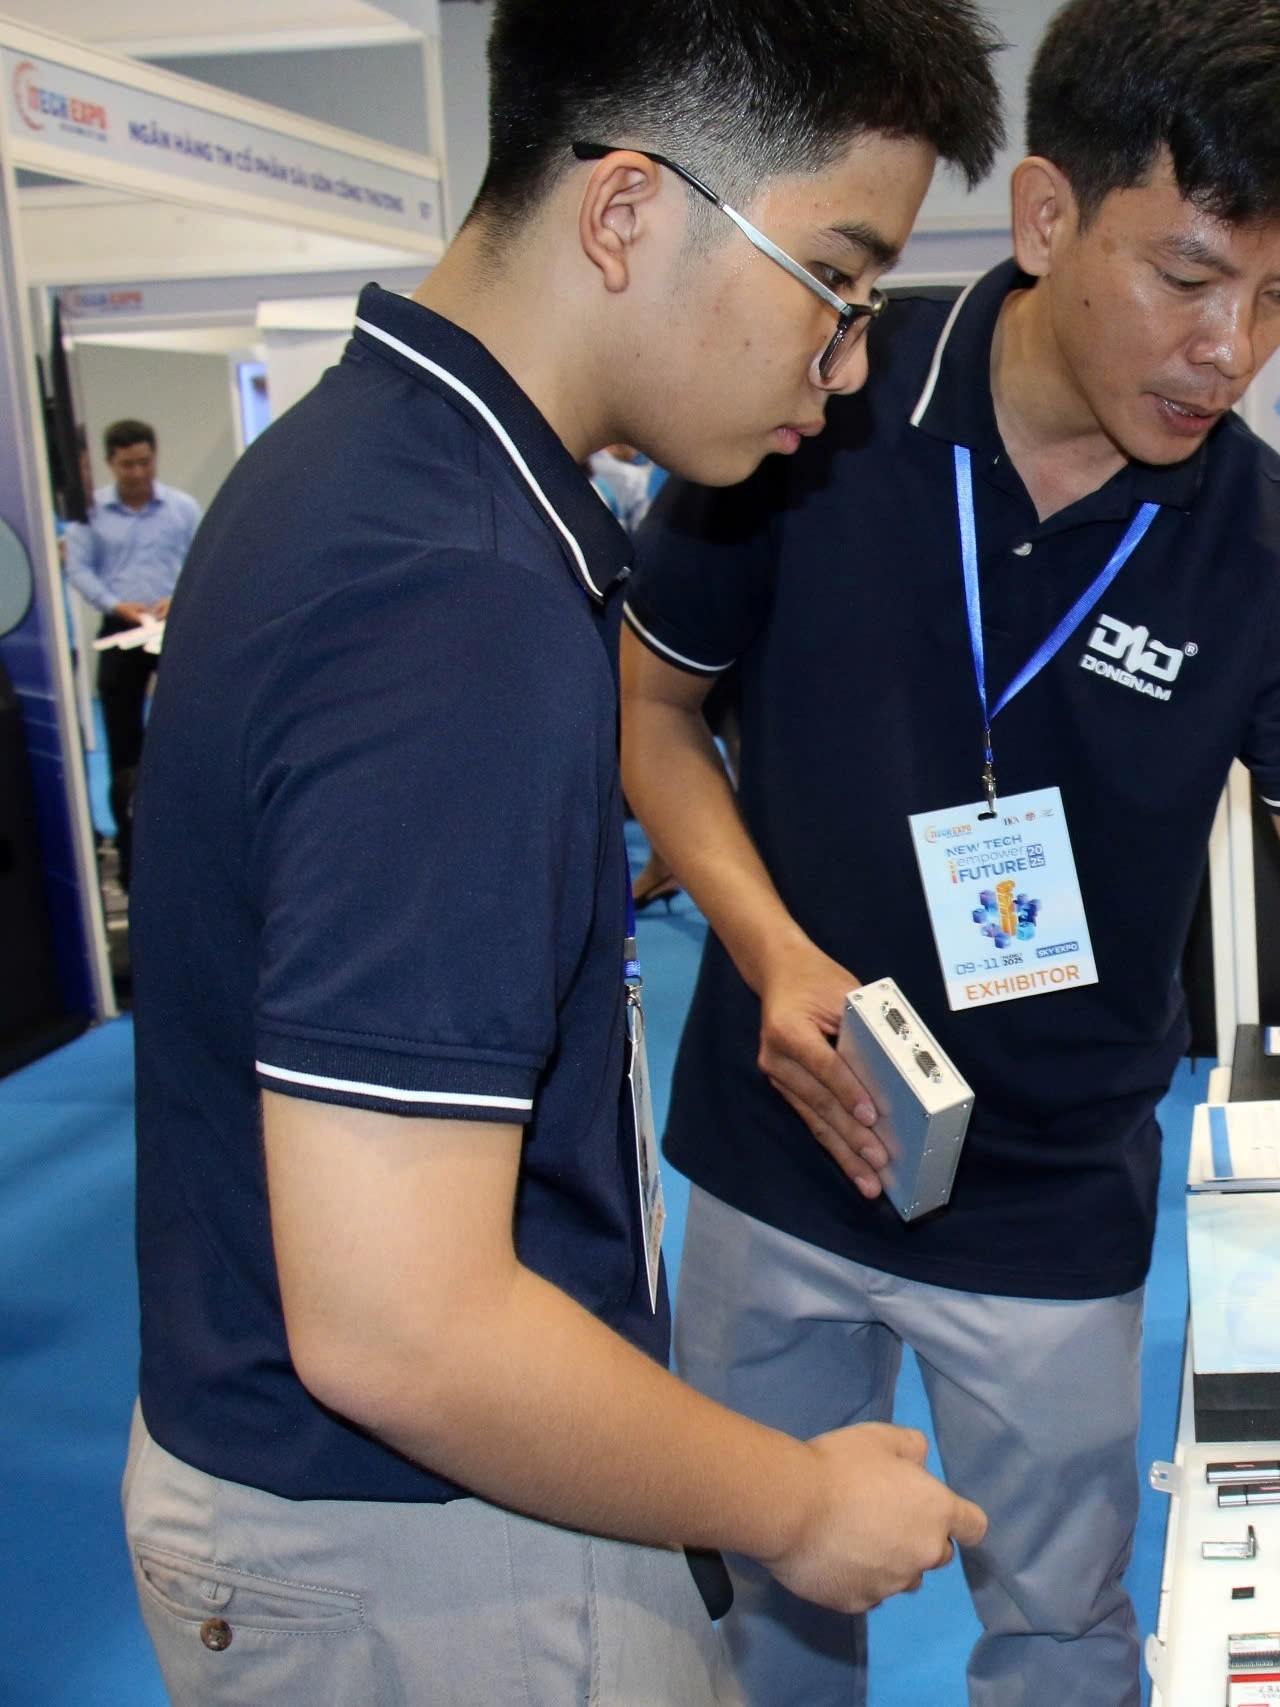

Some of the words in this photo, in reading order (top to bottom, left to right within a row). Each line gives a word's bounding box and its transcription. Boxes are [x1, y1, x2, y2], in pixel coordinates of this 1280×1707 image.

[1080, 654, 1172, 701] DONGNAM
[946, 841, 980, 858] NEW
[983, 834, 1023, 851] TECH
[957, 845, 1025, 868] empower
[1028, 846, 1043, 857] 20
[959, 857, 1028, 884] FUTURE
[1030, 857, 1045, 867] 25
[1038, 946, 1056, 958] SKY
[1055, 942, 1078, 954] EXPO
[1003, 957, 1024, 967] 2025
[966, 964, 1081, 1001] EXHIBITOR
